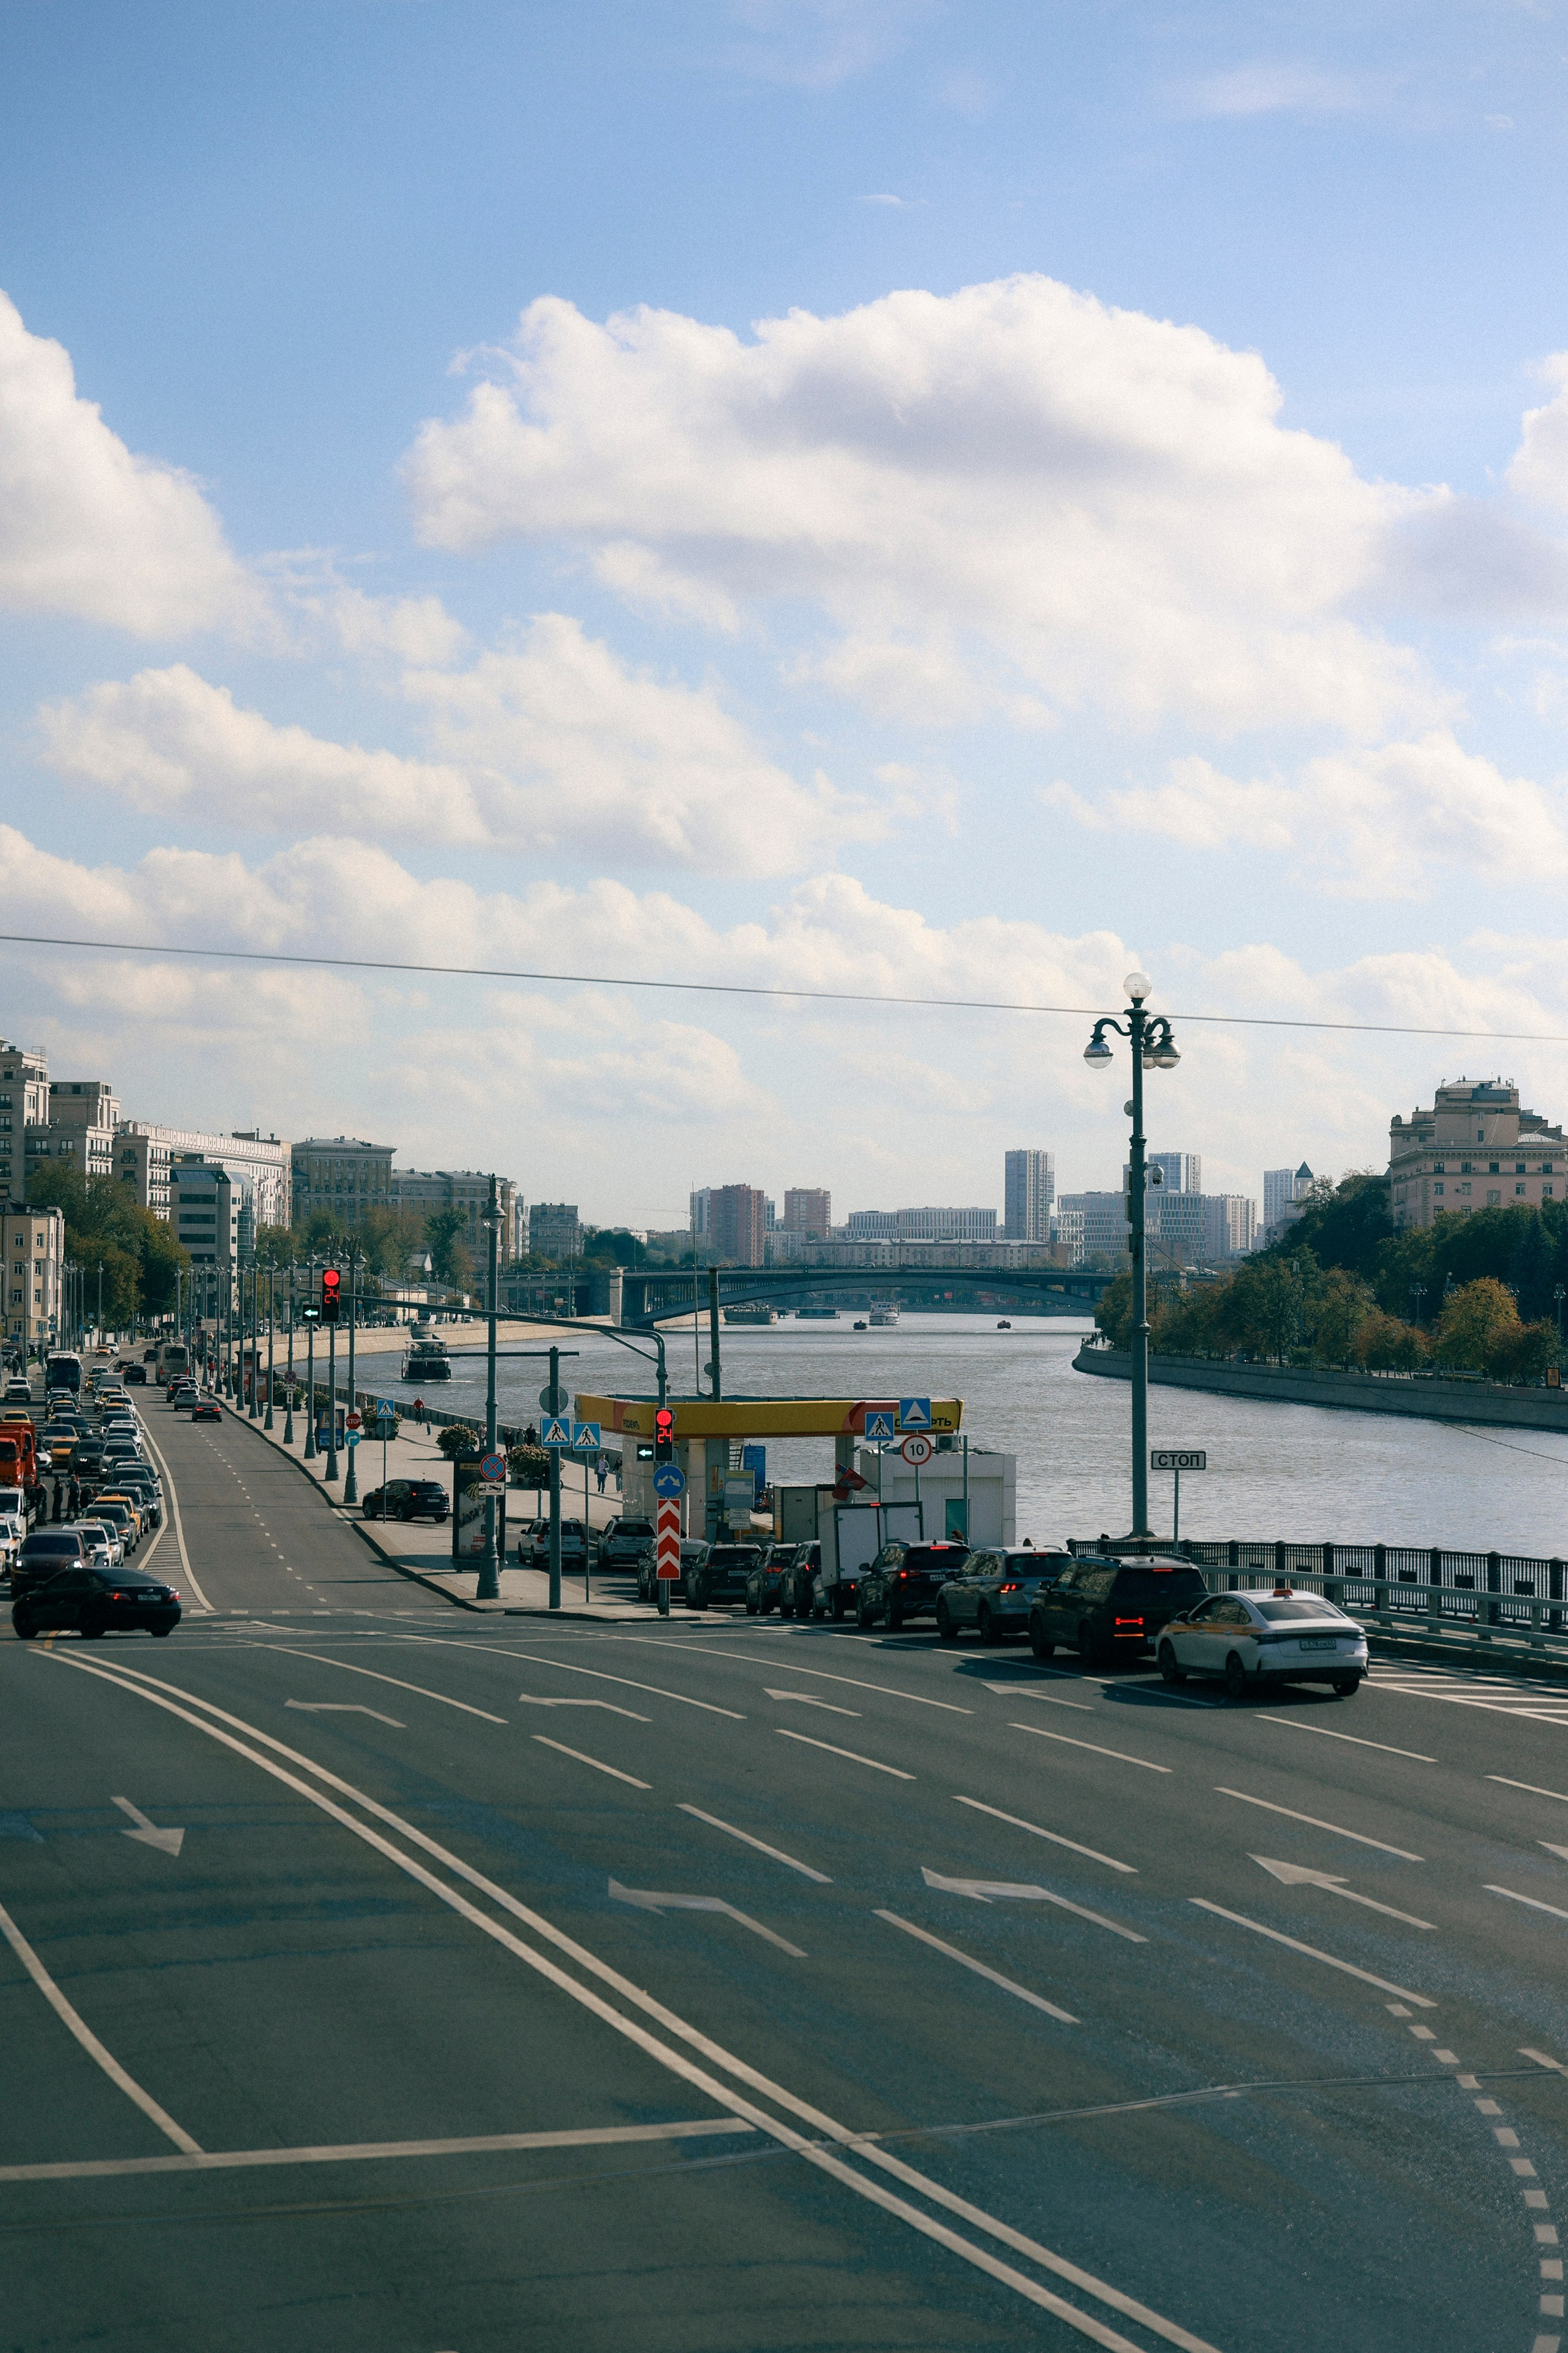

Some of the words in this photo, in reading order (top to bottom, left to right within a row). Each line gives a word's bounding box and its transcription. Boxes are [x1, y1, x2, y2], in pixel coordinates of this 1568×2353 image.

[325, 1288, 339, 1304] 24
[657, 1427, 673, 1443] 24
[910, 1444, 924, 1456] 10
[1158, 1454, 1199, 1467] СТОП
